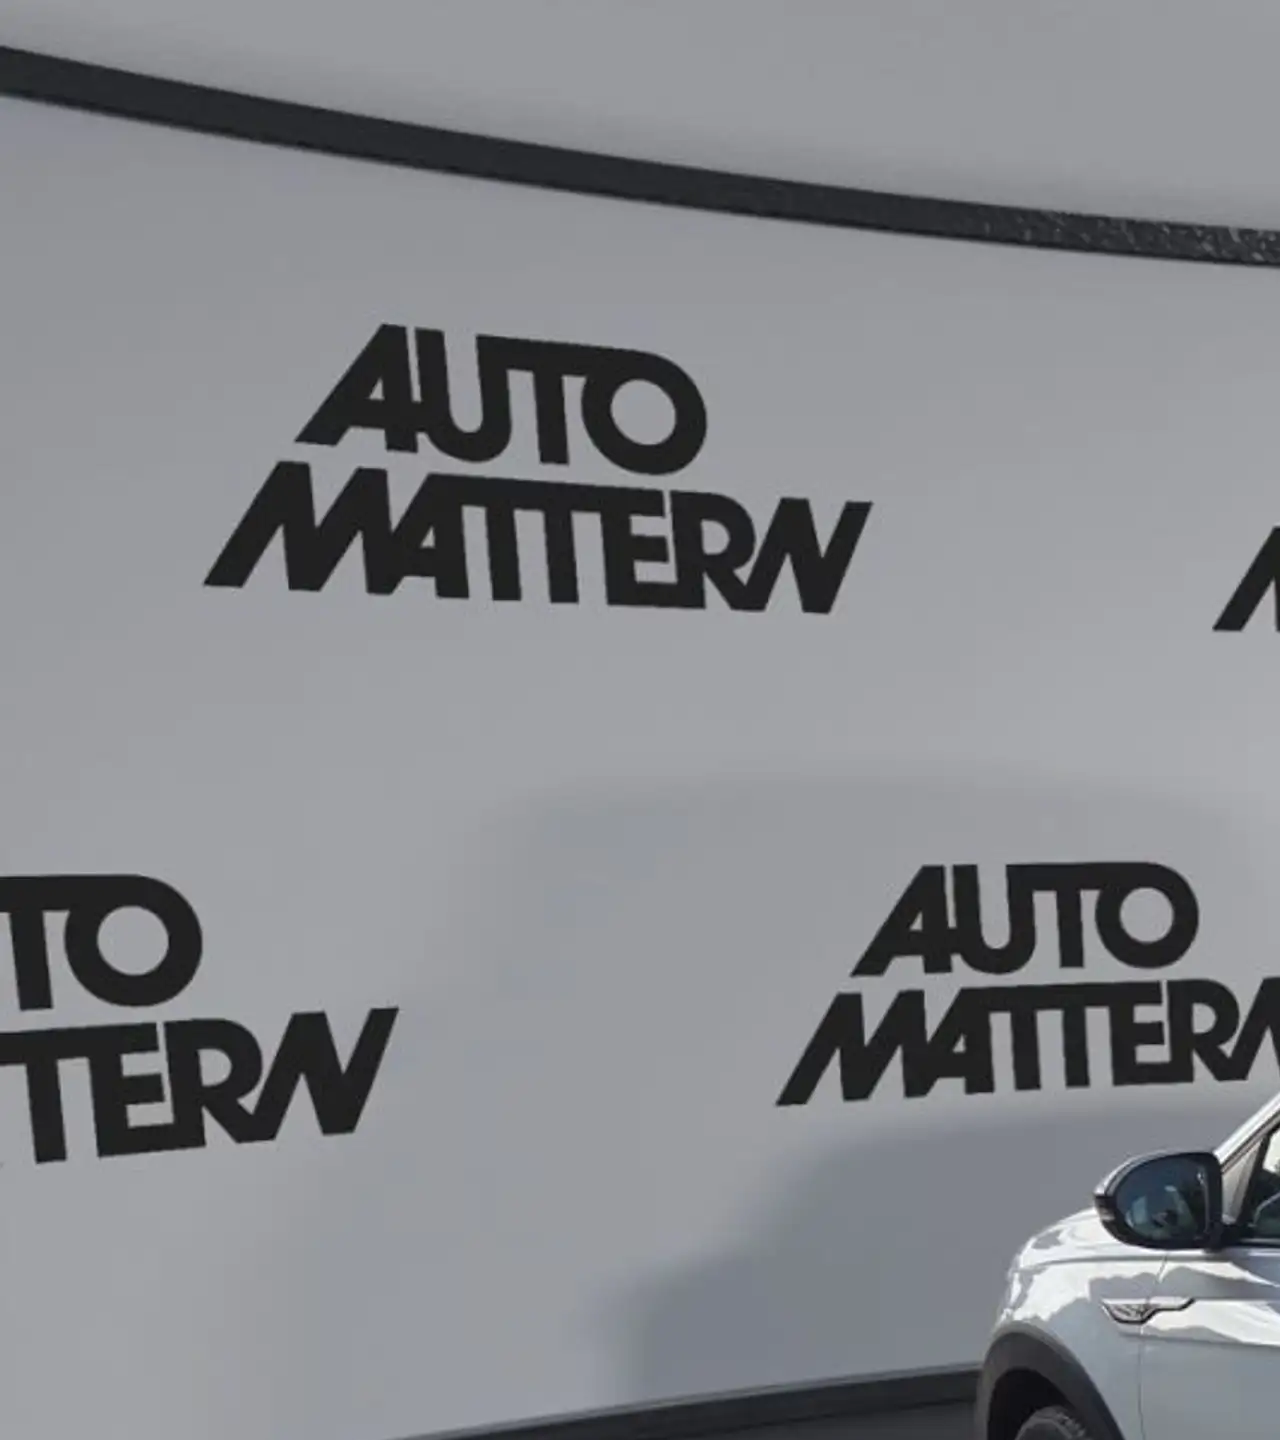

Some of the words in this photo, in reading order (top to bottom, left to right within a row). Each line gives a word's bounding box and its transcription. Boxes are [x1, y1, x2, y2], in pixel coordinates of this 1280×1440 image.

[295, 324, 707, 475] AUTO
[203, 461, 873, 615] MATTERN
[0, 874, 203, 1010] TO
[851, 862, 1199, 976] AUTO
[0, 1007, 399, 1164] TERN
